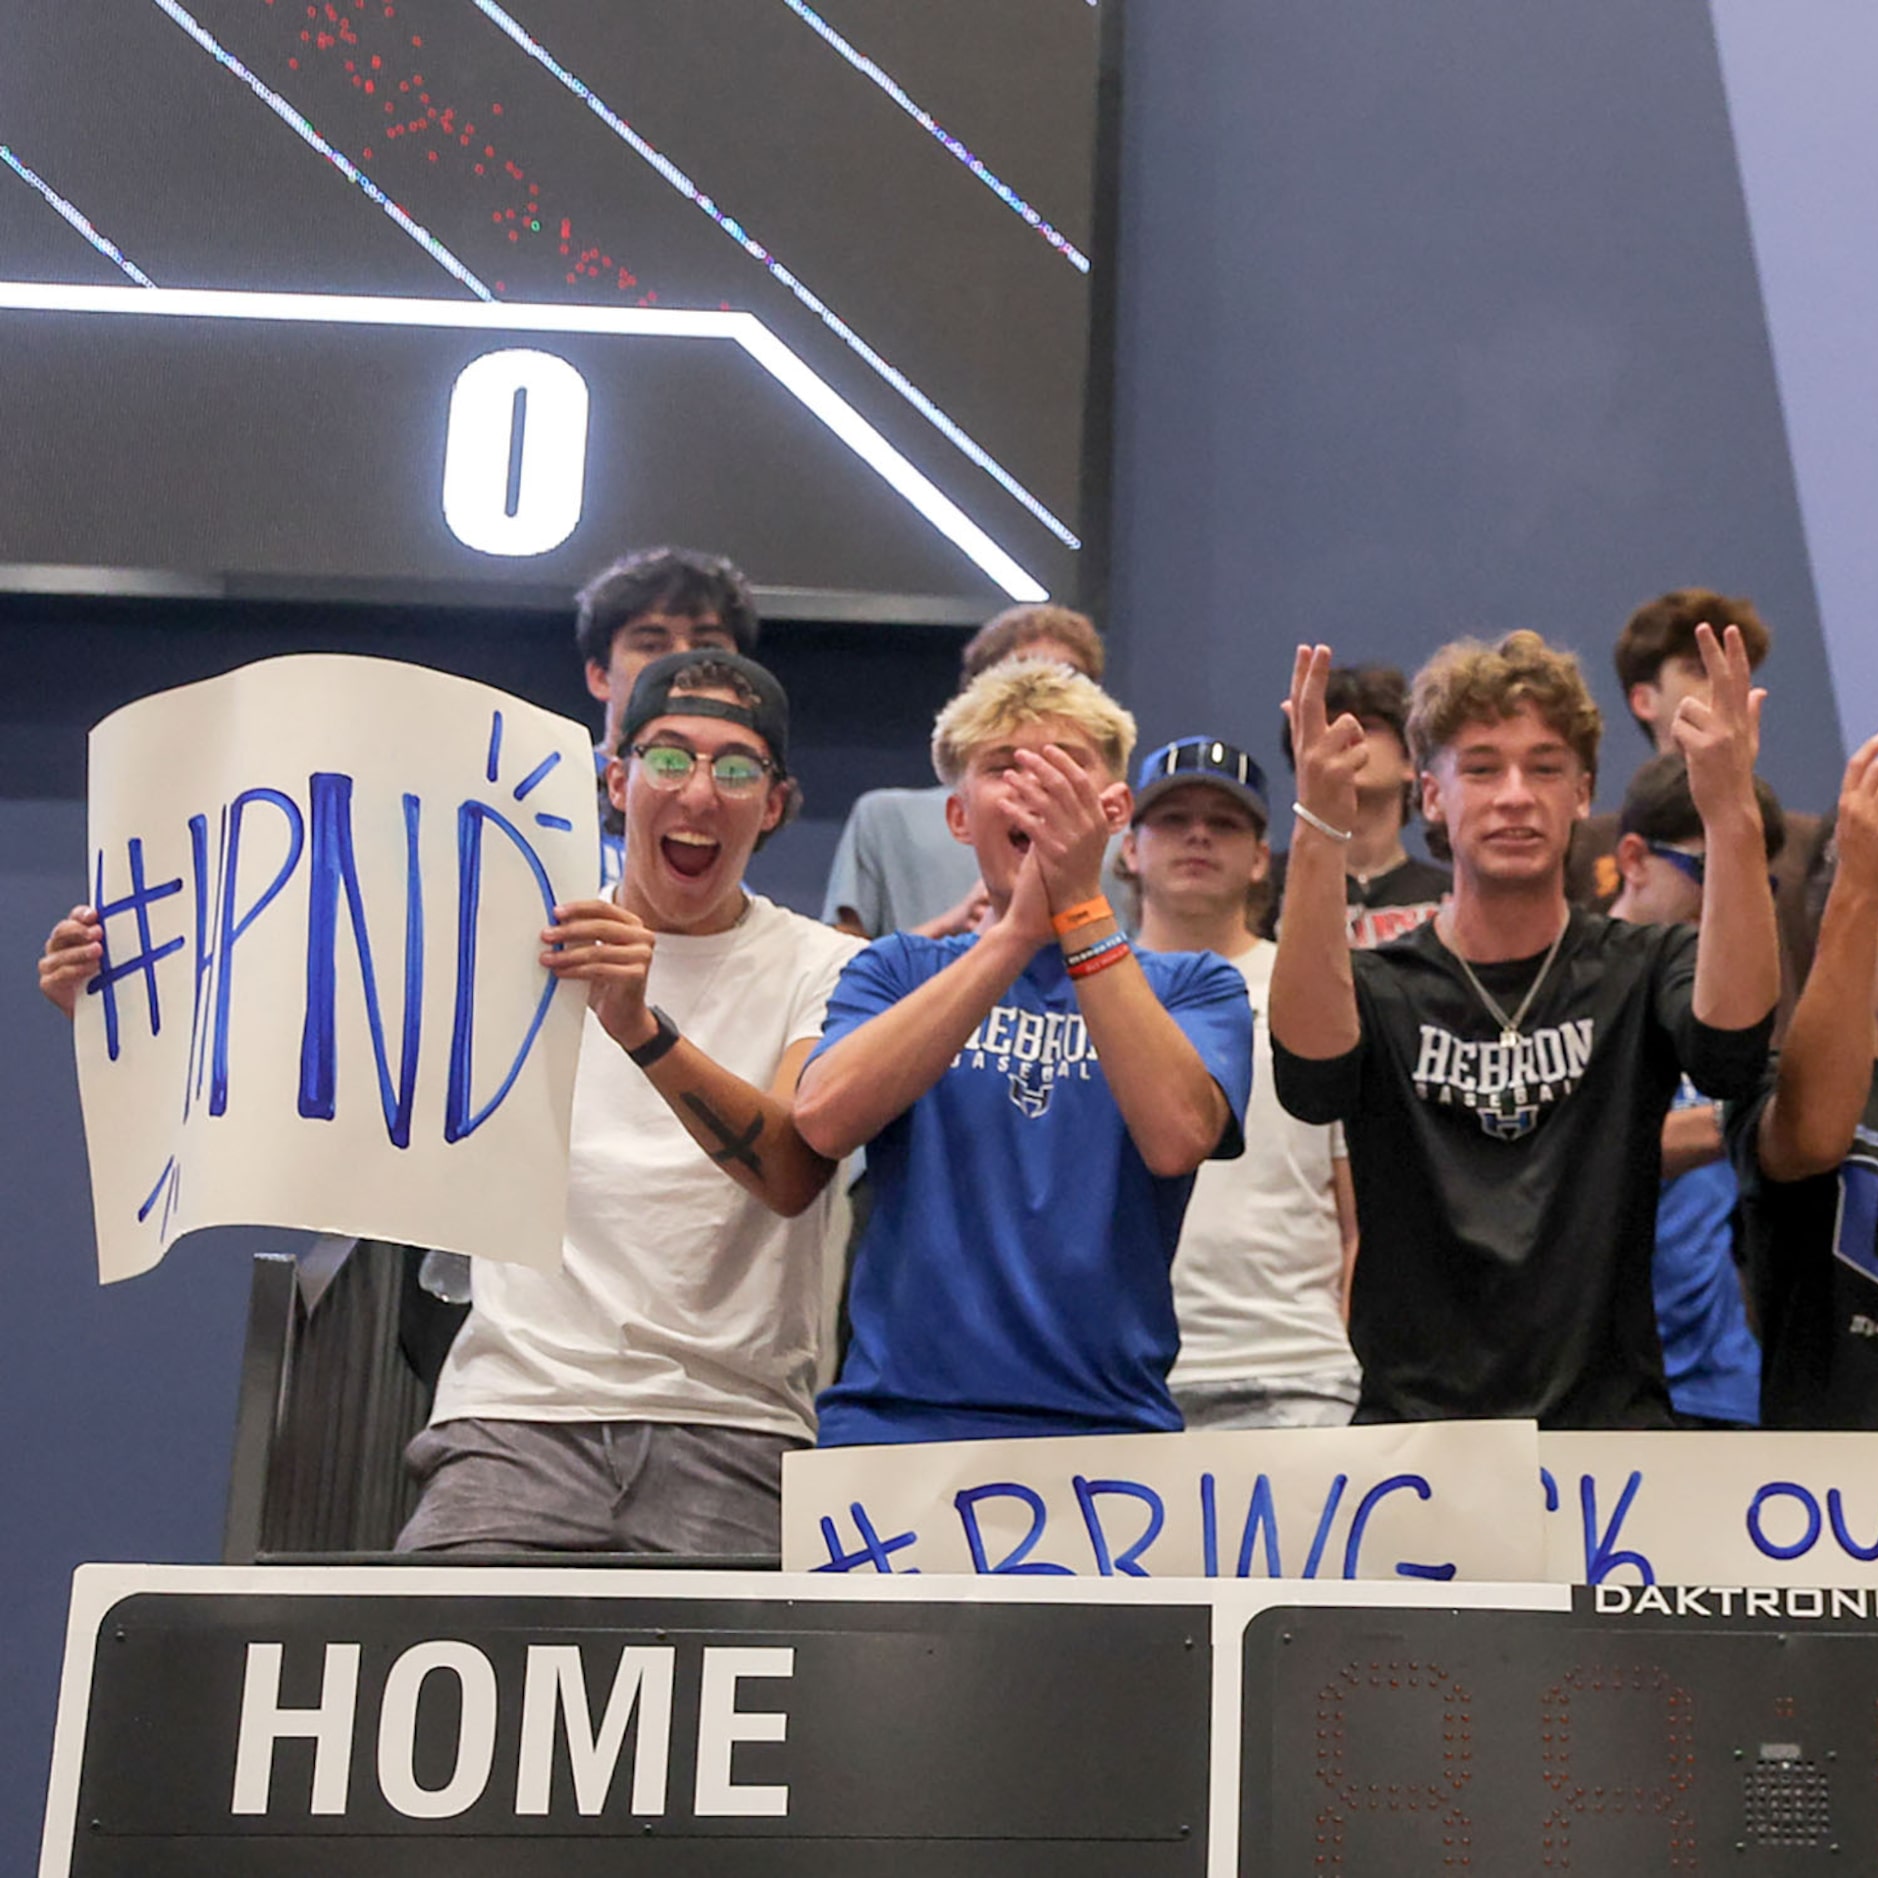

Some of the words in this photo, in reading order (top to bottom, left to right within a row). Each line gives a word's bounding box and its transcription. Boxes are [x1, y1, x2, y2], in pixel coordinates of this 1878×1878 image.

[442, 347, 590, 557] 0
[950, 1050, 1092, 1083] ASEBAL
[964, 1005, 1099, 1063] EBRO
[1412, 1018, 1595, 1095] HEBRON
[231, 1639, 796, 1819] HOME
